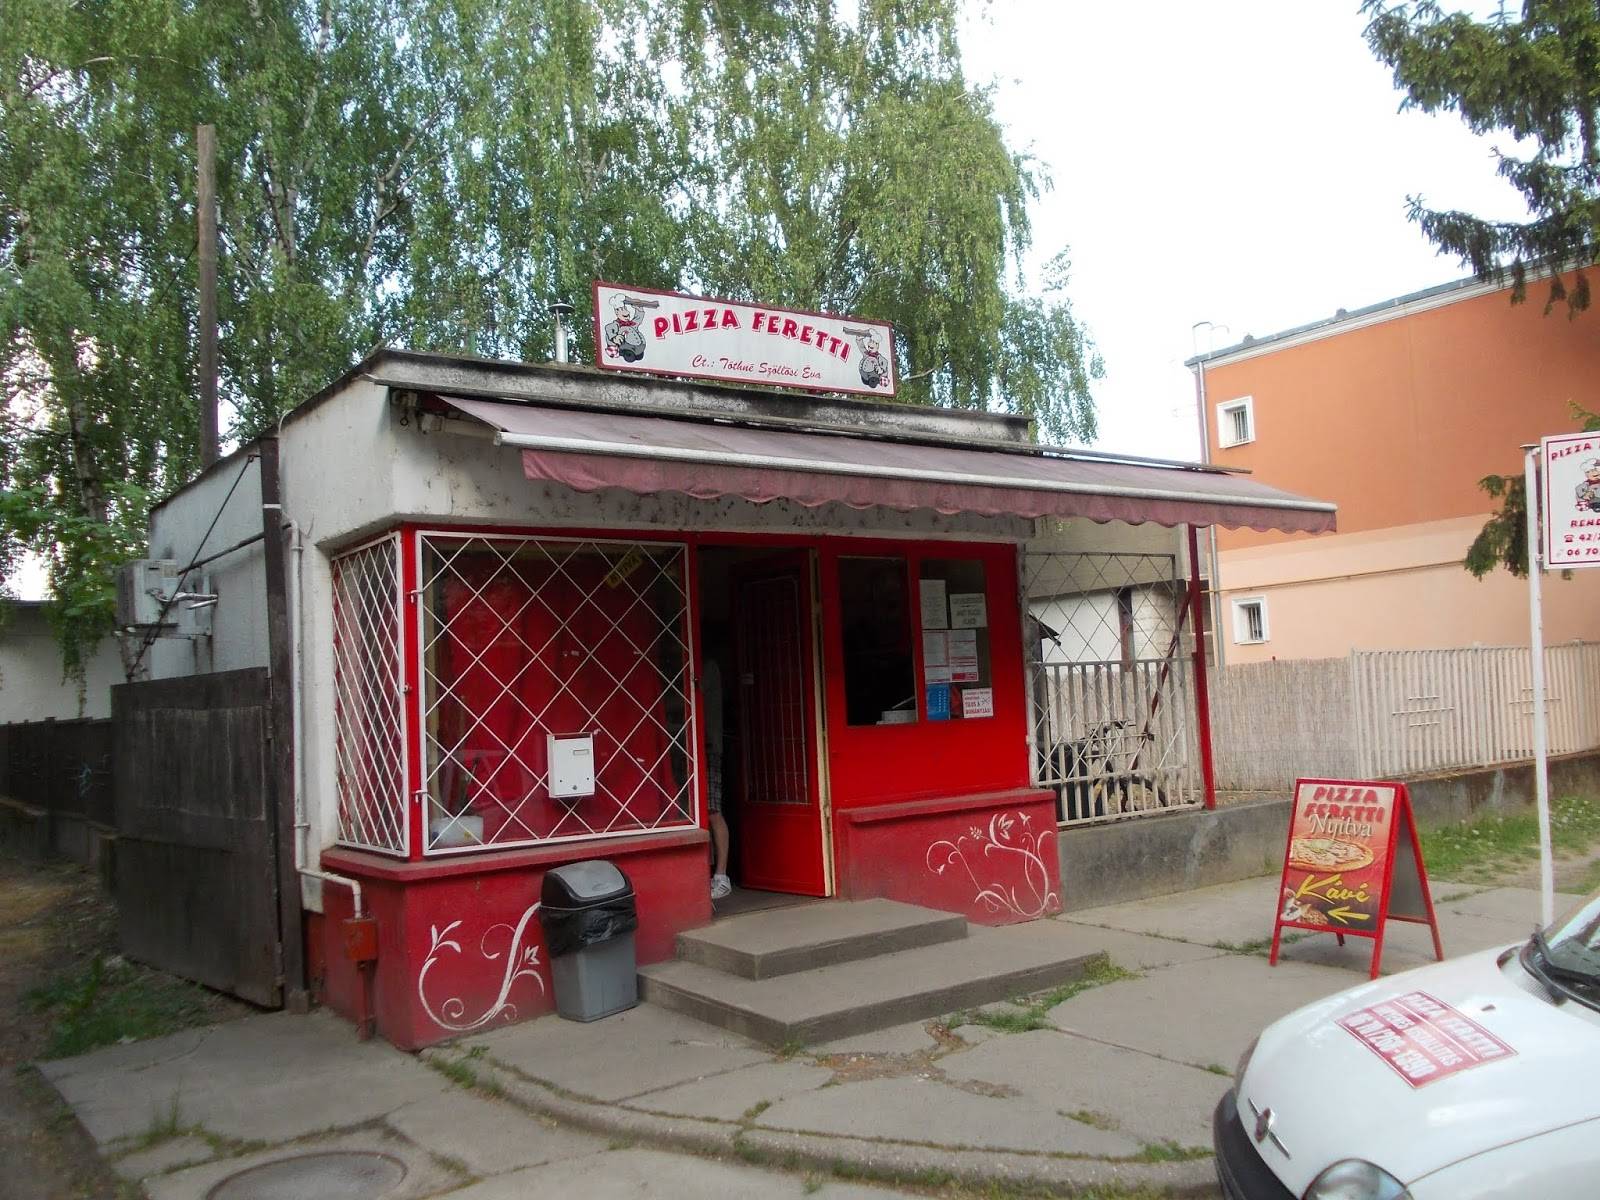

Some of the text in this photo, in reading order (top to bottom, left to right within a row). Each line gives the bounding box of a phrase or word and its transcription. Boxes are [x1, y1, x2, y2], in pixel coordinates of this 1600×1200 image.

[653, 309, 852, 362] PIZZA FERETTI
[1551, 443, 1592, 461] PIZZA
[1313, 786, 1378, 804] PIZZA
[1303, 803, 1386, 823] FERETTI
[1308, 812, 1373, 839] Nyitva
[1296, 873, 1370, 905] Kávé
